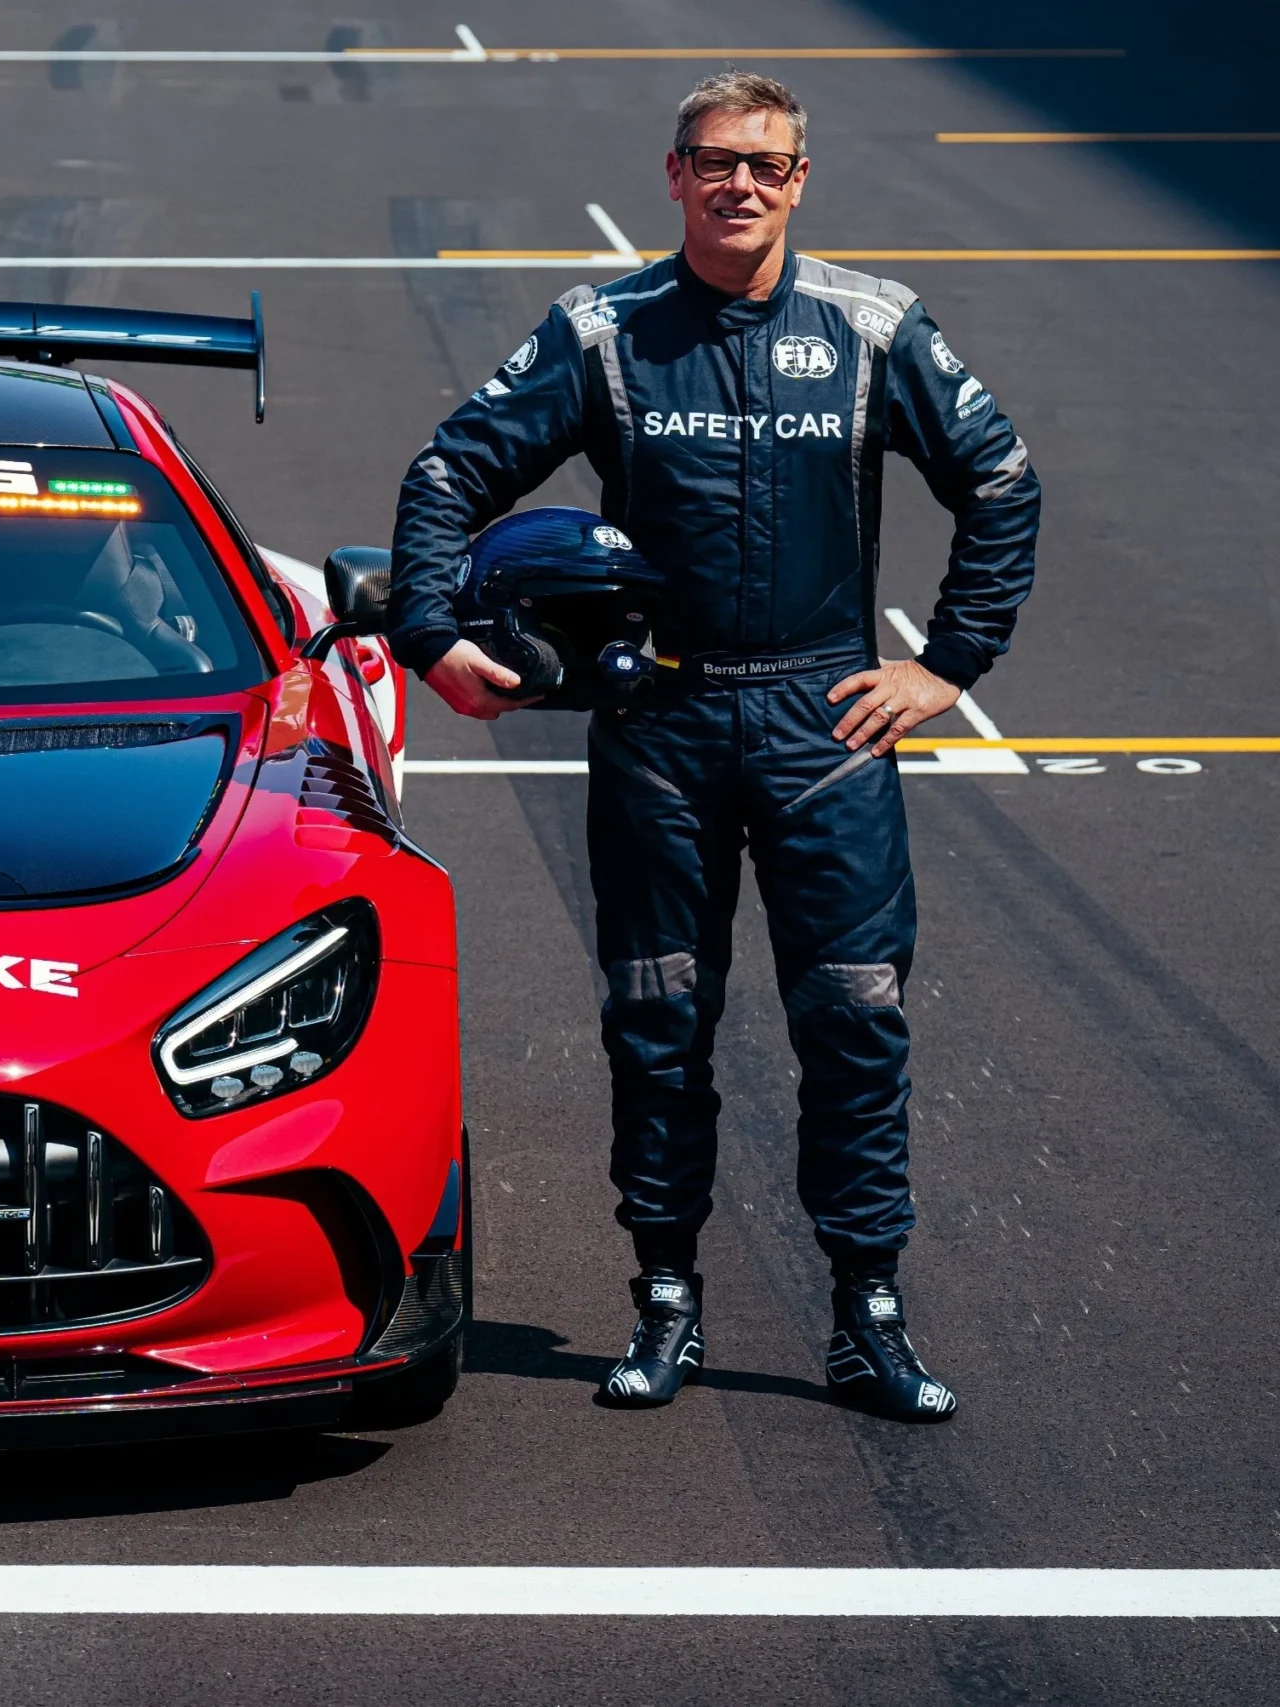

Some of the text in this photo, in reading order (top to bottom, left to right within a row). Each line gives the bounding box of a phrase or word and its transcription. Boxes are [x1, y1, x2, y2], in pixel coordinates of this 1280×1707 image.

[578, 310, 617, 331] OMP
[857, 310, 895, 335] OMP
[644, 411, 843, 440] SAFETY CAR
[703, 663, 746, 675] Bernd
[651, 1287, 682, 1299] OMP
[869, 1300, 896, 1312] OMP
